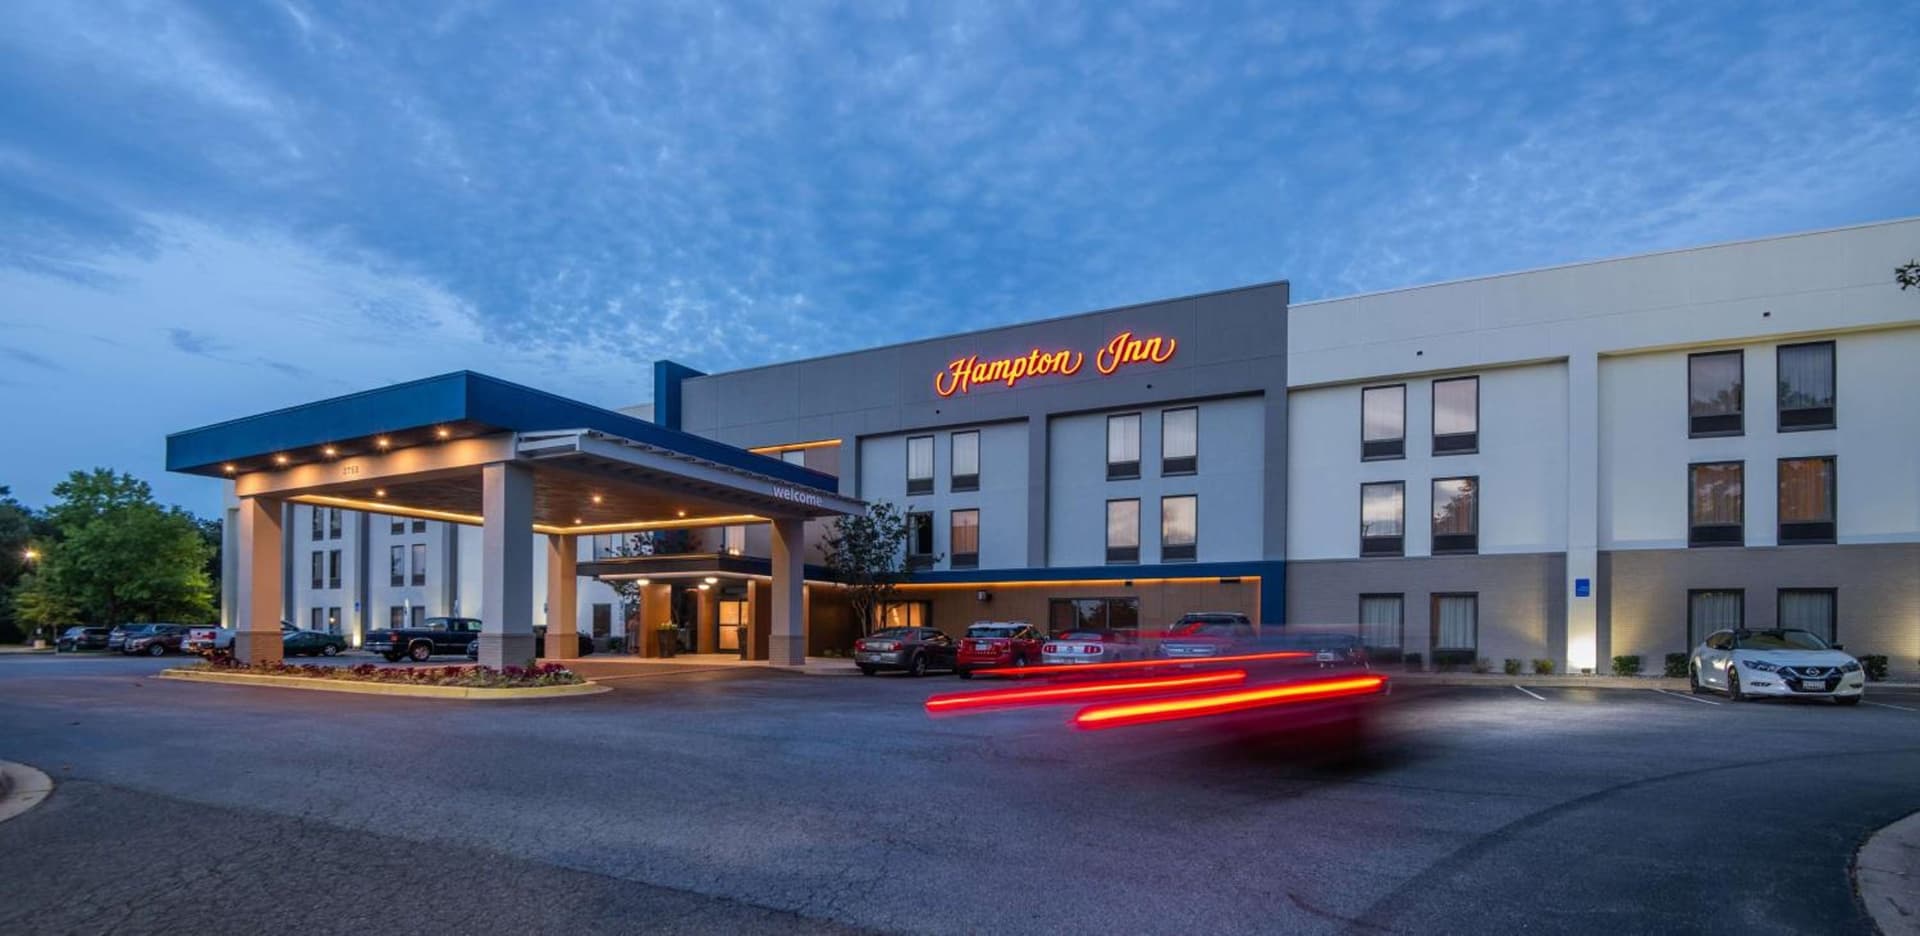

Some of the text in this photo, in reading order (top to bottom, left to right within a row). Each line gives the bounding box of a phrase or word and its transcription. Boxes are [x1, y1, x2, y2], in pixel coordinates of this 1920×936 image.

[936, 331, 1176, 396] Hampton Inn
[772, 486, 823, 506] welcome
